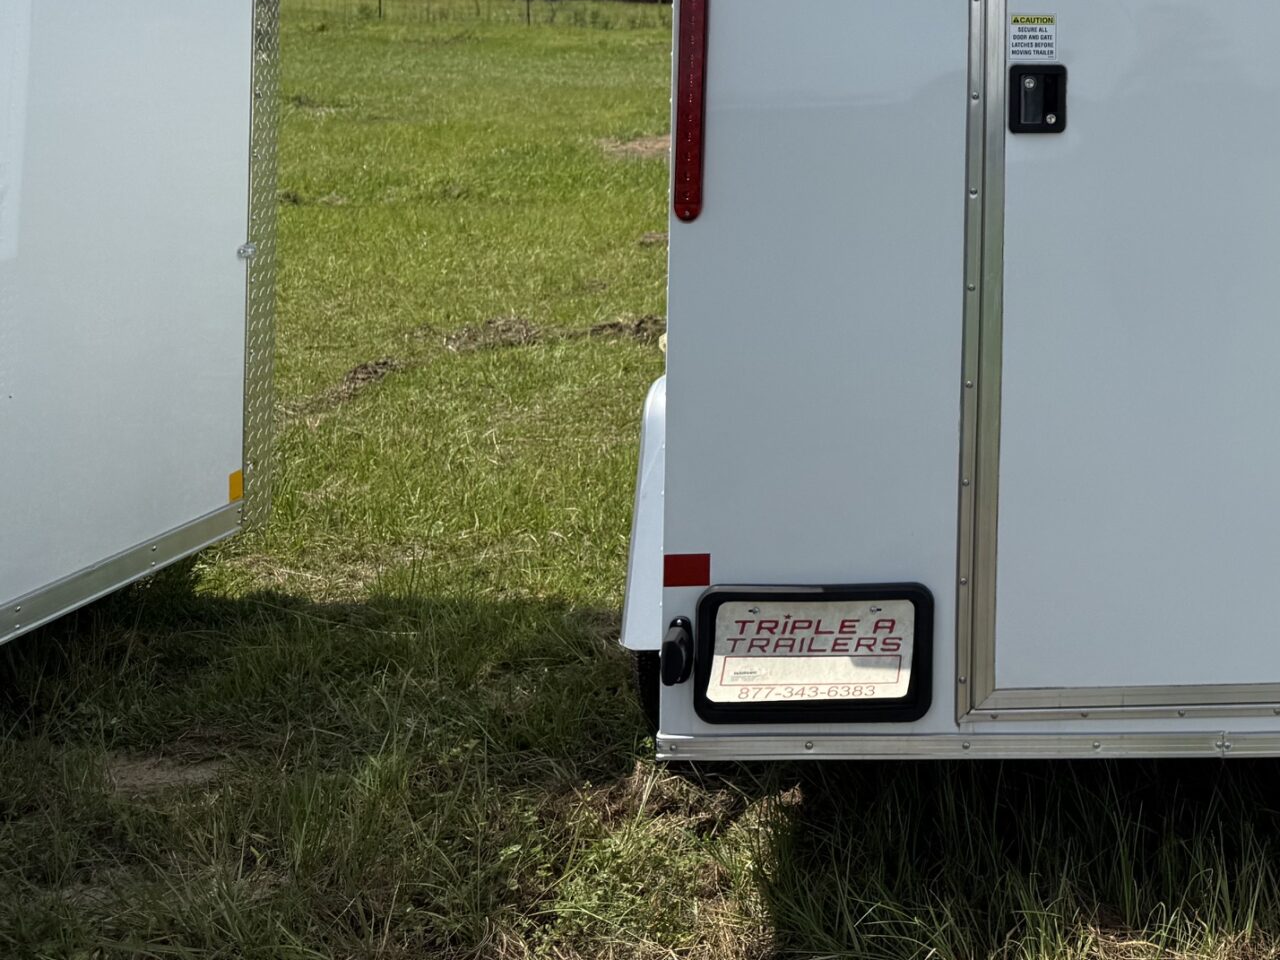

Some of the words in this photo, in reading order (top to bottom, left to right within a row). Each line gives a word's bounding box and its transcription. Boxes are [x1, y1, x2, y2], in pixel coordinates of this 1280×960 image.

[872, 618, 896, 634] A
[726, 637, 903, 653] TRAILERS
[737, 685, 876, 700] 877-343-6383
